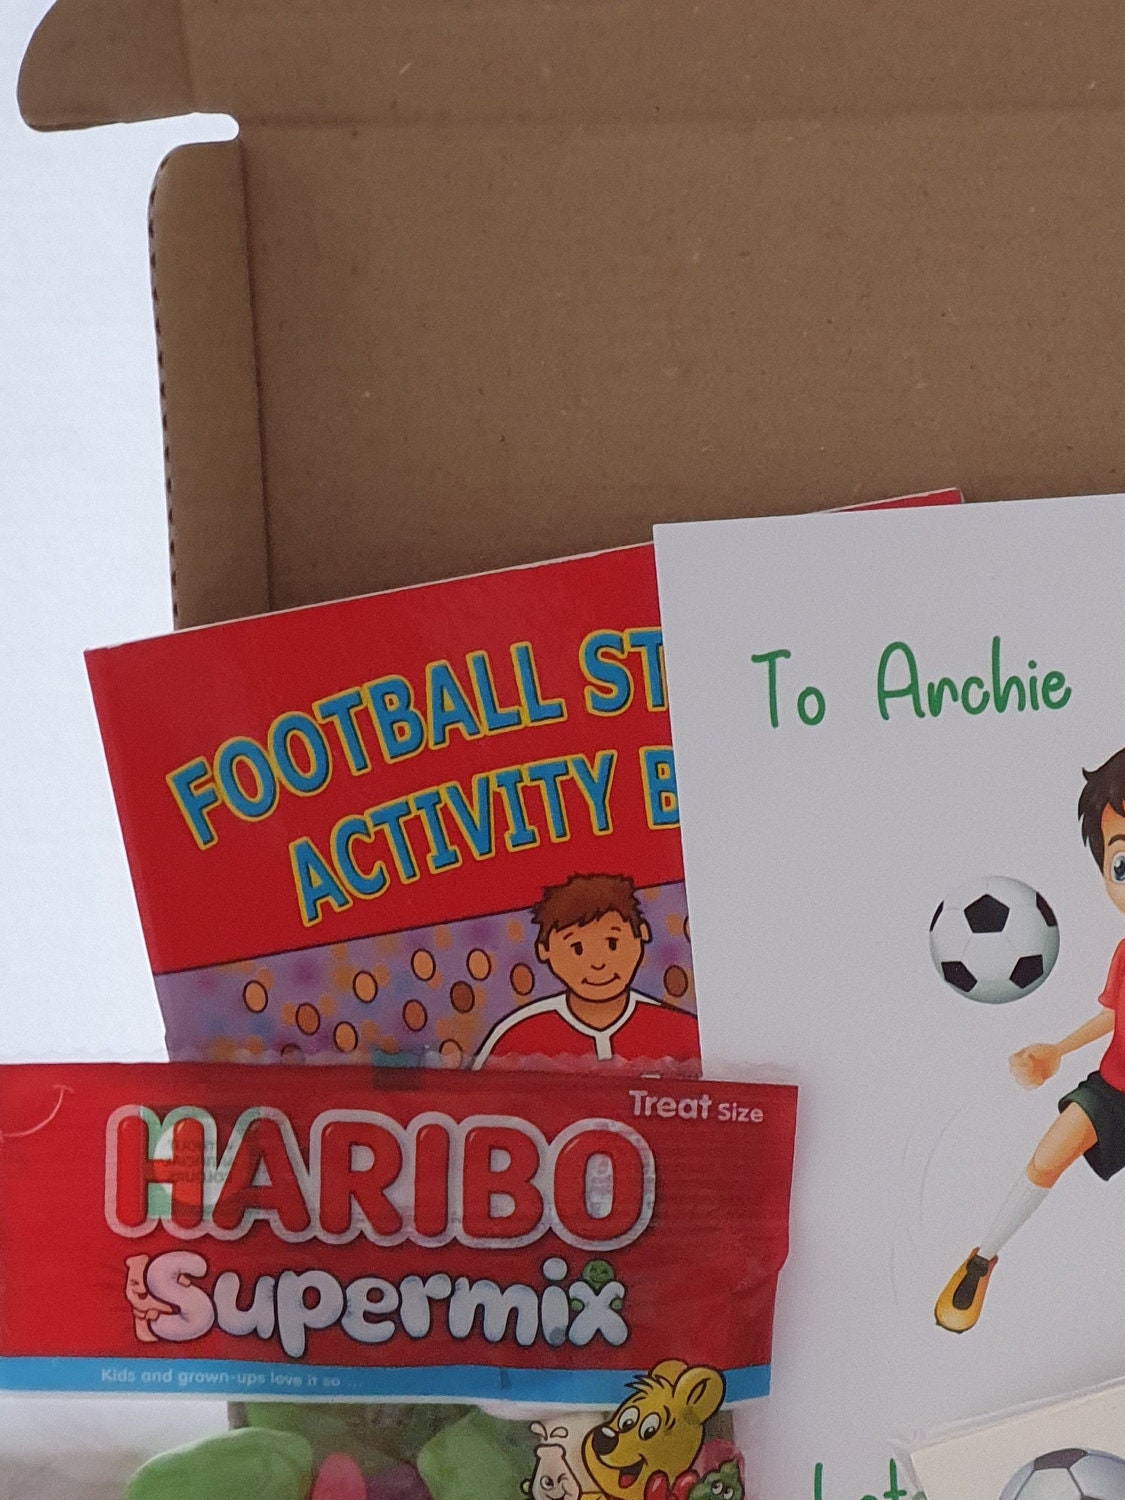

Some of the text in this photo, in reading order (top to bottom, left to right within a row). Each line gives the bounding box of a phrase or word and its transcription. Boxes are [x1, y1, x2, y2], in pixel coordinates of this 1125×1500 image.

[751, 635, 1073, 729] To Archie
[166, 640, 564, 849] FOOTBALL
[289, 750, 618, 927] ACTIVITY
[629, 1090, 764, 1123] Treat Size
[104, 1104, 657, 1251] HARIBO
[144, 1252, 629, 1358] Supermix
[101, 1368, 136, 1383] Kids
[141, 1369, 173, 1384] and
[178, 1370, 266, 1387] grown-ups
[270, 1371, 302, 1386] love
[307, 1374, 318, 1386] it
[322, 1376, 341, 1387] so
